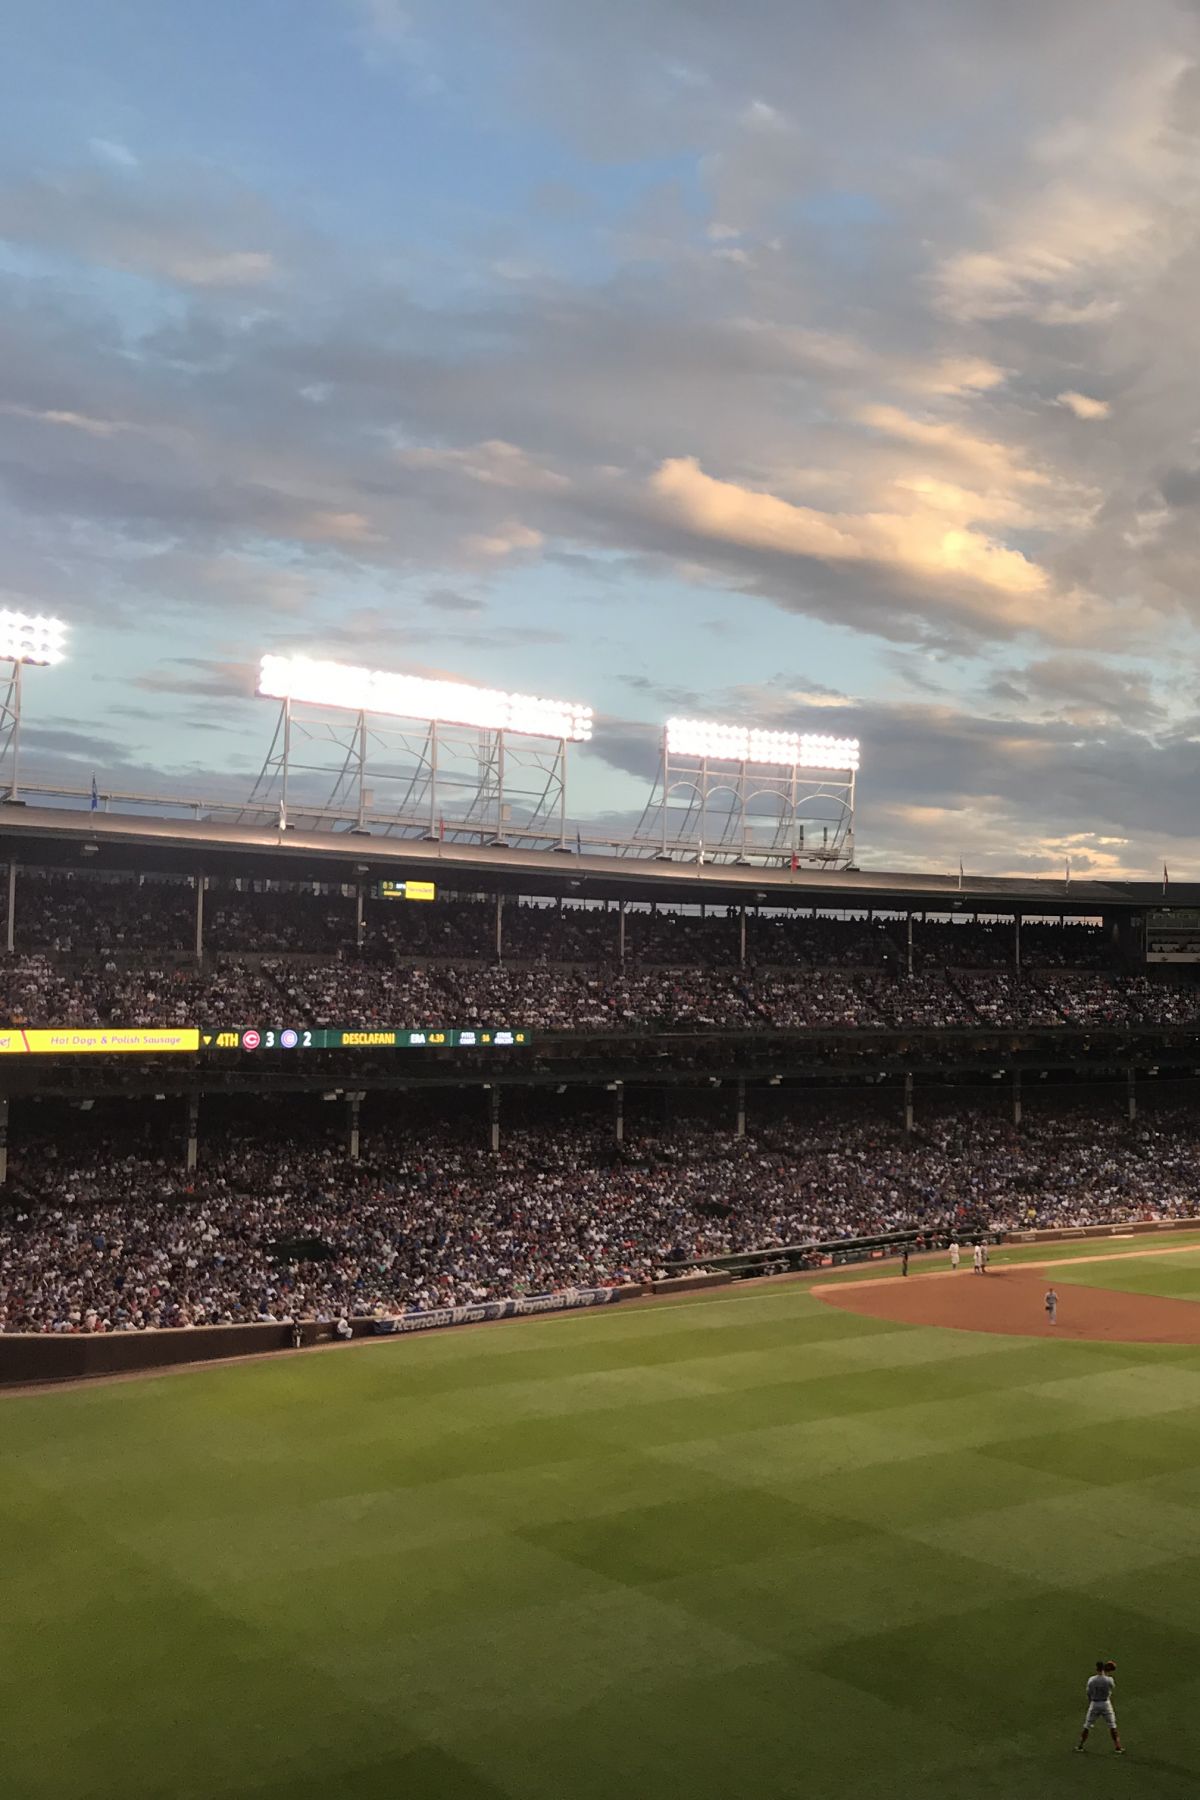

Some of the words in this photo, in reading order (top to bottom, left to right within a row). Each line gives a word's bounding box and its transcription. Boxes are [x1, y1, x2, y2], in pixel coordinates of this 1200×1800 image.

[51, 1036, 69, 1045] Hot
[73, 1036, 97, 1047] Dogs
[101, 1036, 108, 1045] &
[111, 1036, 140, 1045] Polish
[143, 1036, 181, 1046] Sausage
[216, 1032, 239, 1047] 4TH
[265, 1031, 275, 1047] 3
[303, 1031, 312, 1047] 2
[342, 1032, 396, 1045] DESCLAFANI
[410, 1033, 426, 1044] ERA
[514, 1295, 564, 1313] Reynolds
[566, 1289, 596, 1306] Wrap
[391, 1311, 452, 1331] Reynolds
[453, 1309, 486, 1322] Wrap
